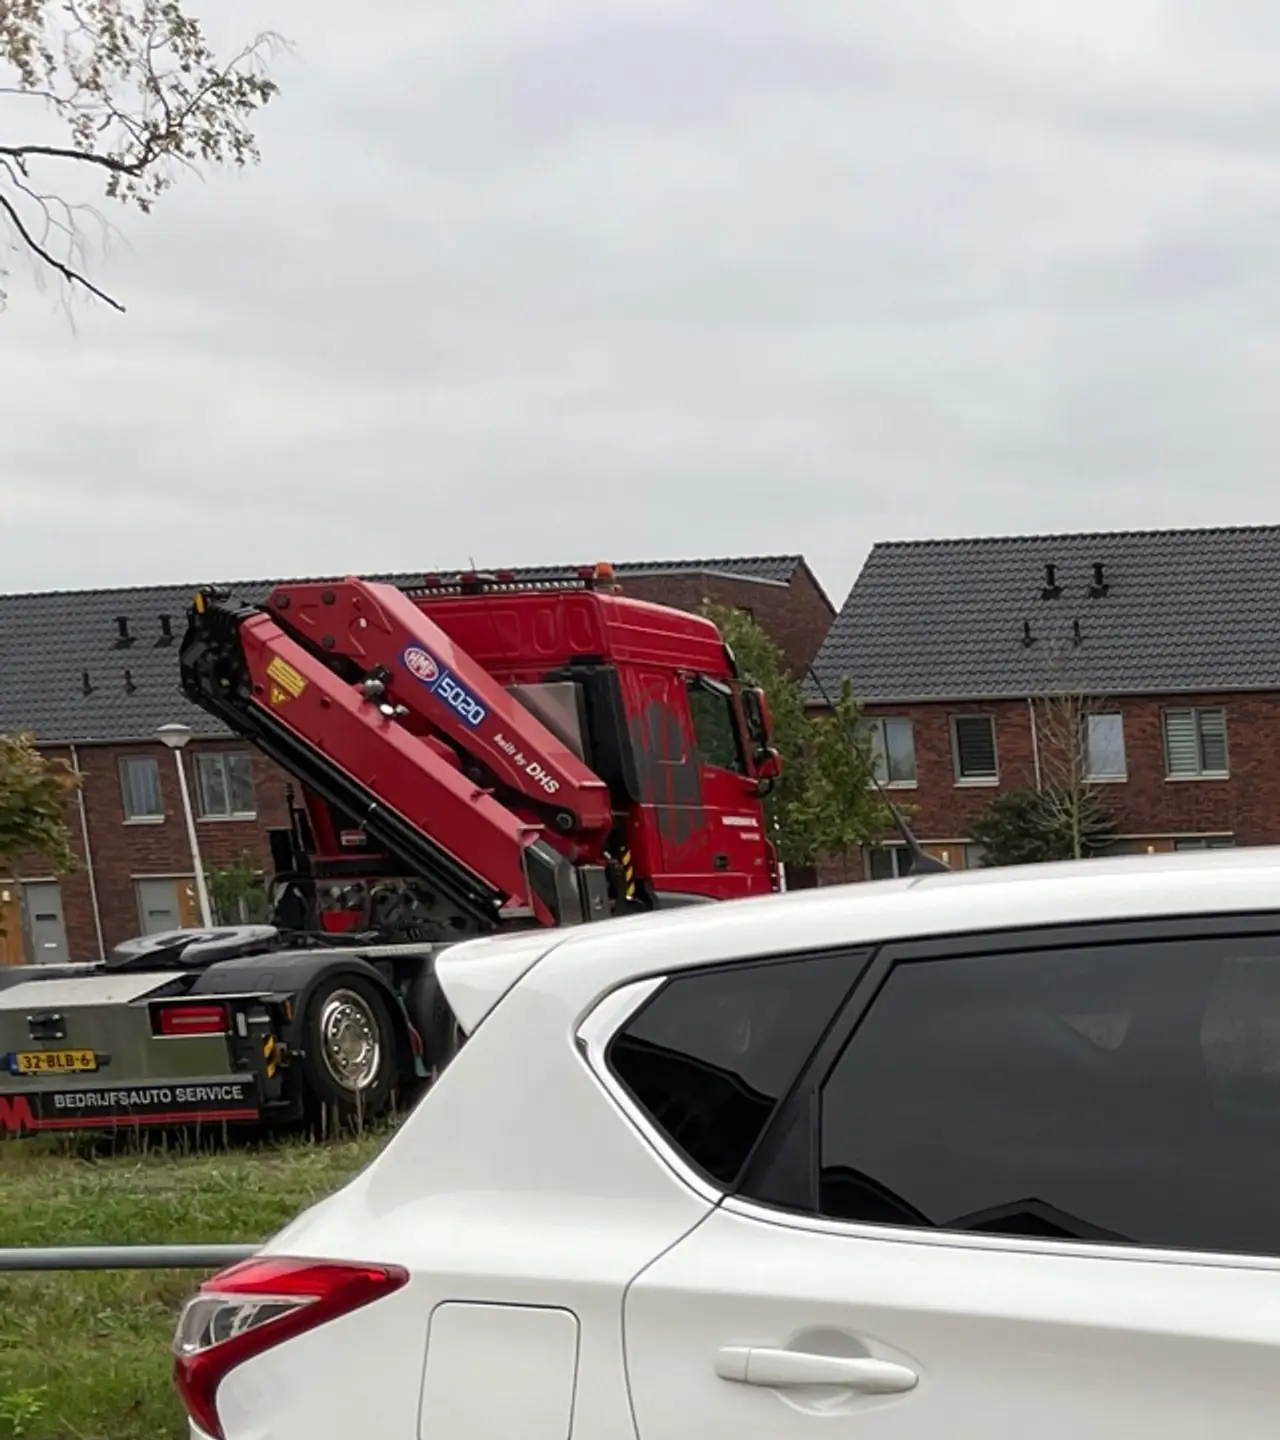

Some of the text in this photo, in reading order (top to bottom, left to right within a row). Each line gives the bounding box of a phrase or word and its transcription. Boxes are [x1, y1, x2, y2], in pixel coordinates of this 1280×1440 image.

[405, 648, 438, 680] HMF
[438, 677, 486, 725] 5020
[525, 762, 560, 794] DHS
[54, 1085, 243, 1109] BEDRIJFSAUTO SERVICE
